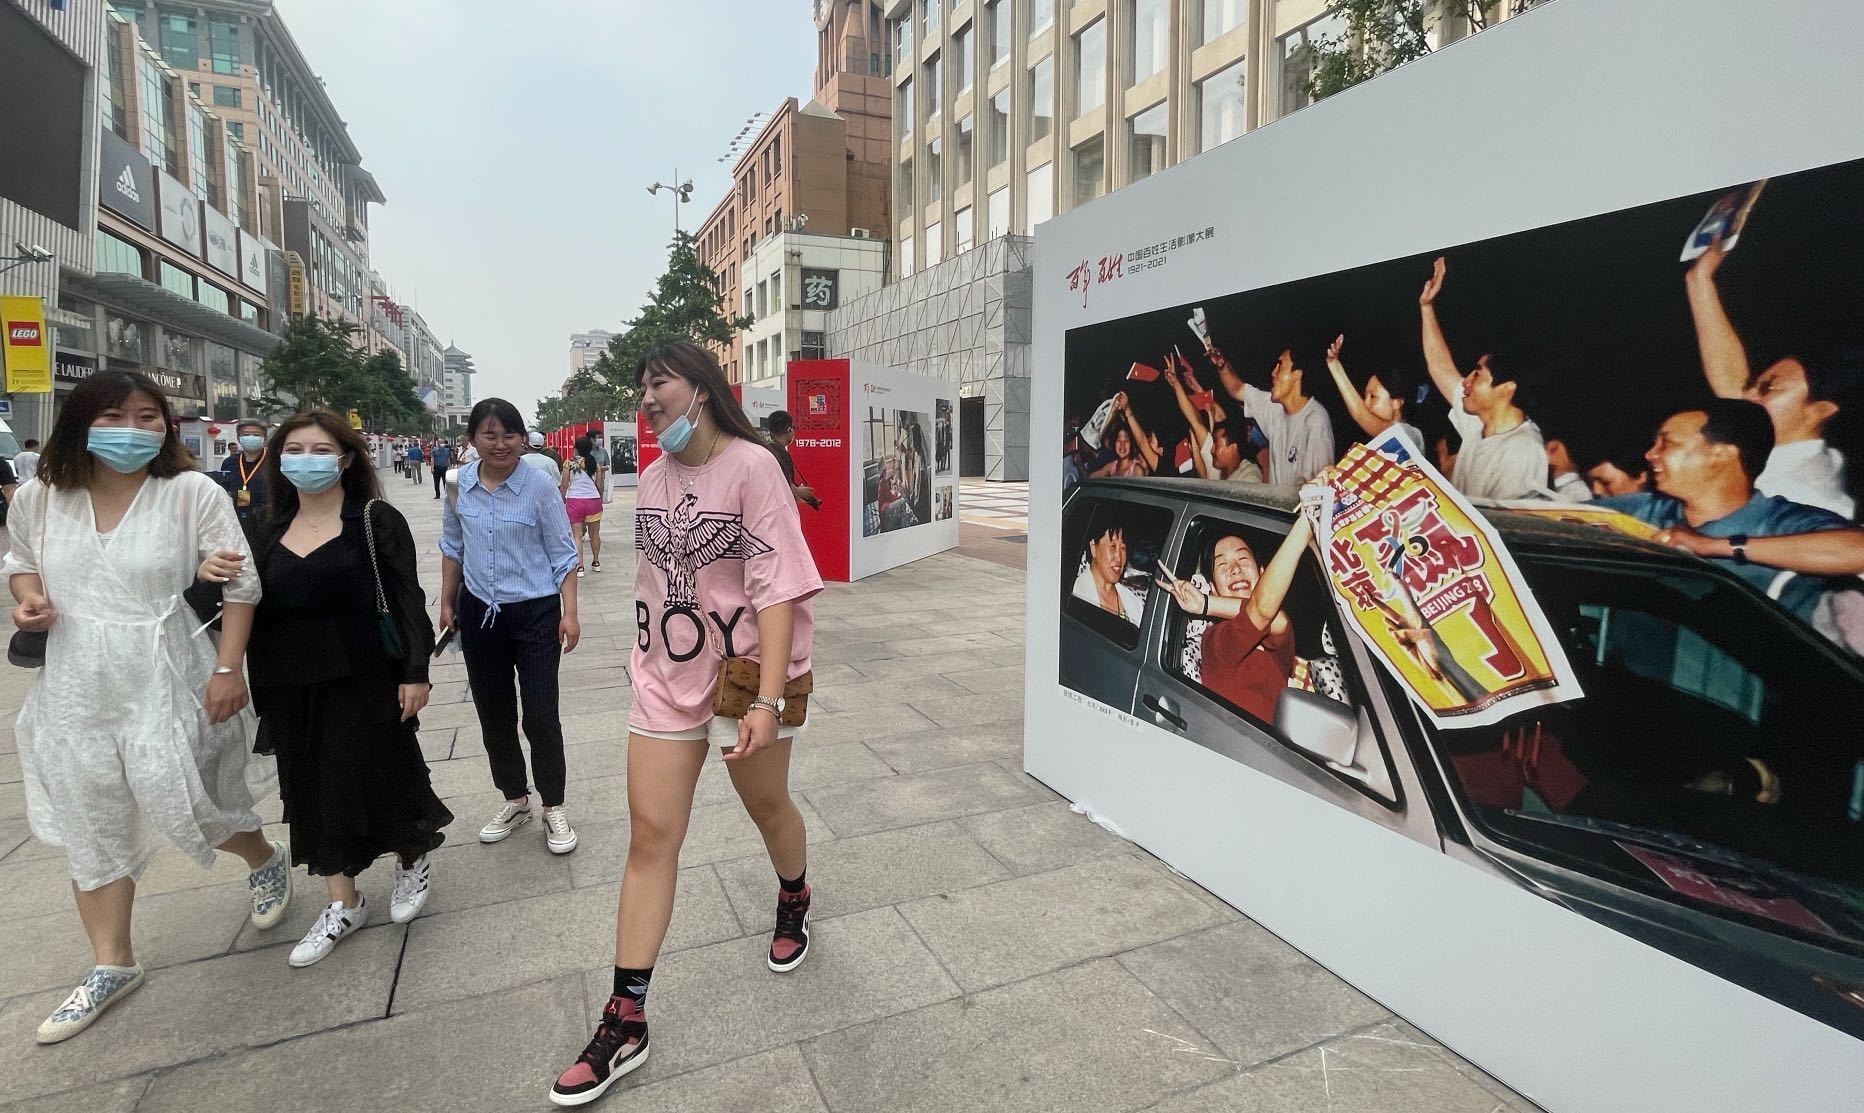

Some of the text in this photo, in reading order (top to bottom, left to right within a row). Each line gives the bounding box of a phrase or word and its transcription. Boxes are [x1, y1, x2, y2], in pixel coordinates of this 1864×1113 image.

[116, 181, 140, 203] adidas
[1127, 226, 1215, 262] 中国百姓生活影像大展
[804, 275, 833, 306] 药
[11, 328, 39, 339] LEGO
[795, 438, 842, 448] 1978-2012
[1420, 586, 1466, 619] BEIJING
[635, 600, 747, 663] BOY
